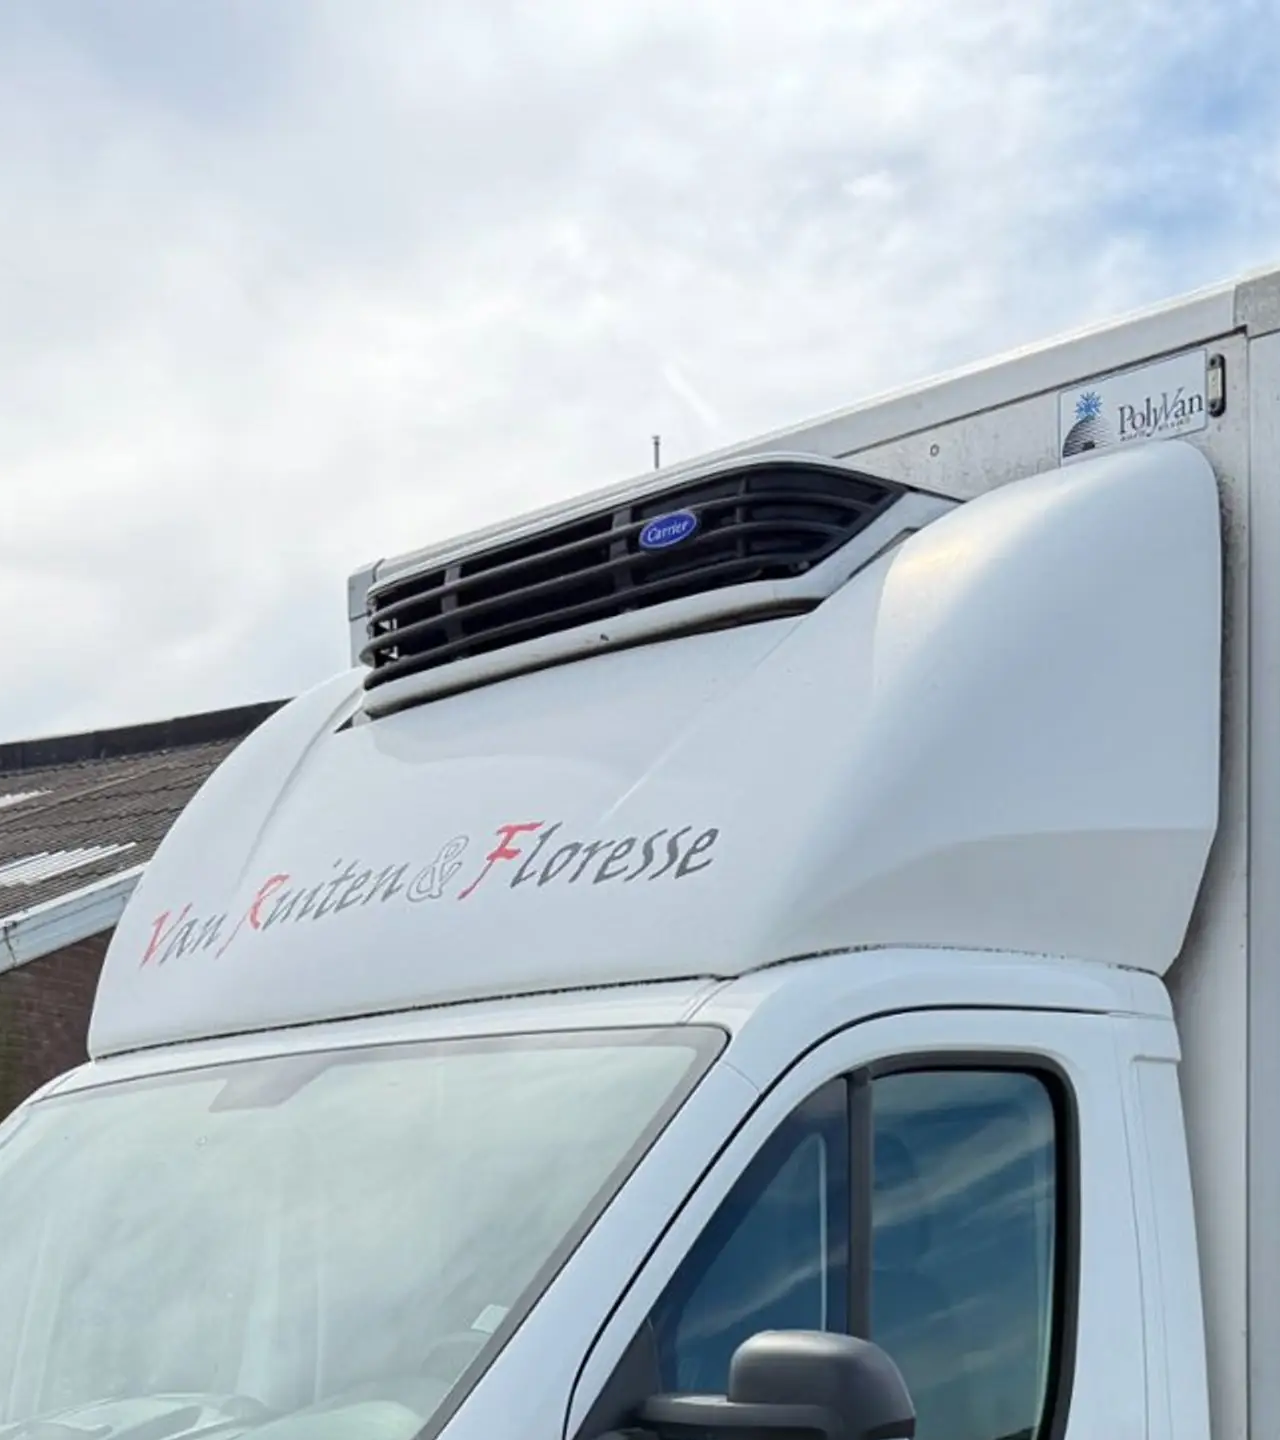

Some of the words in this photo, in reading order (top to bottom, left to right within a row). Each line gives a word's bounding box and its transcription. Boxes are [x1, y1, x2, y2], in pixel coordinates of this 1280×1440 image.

[647, 519, 690, 543] Carrier
[139, 903, 226, 969] Van
[216, 858, 410, 960] Ruiten
[457, 821, 721, 900] Floresse
